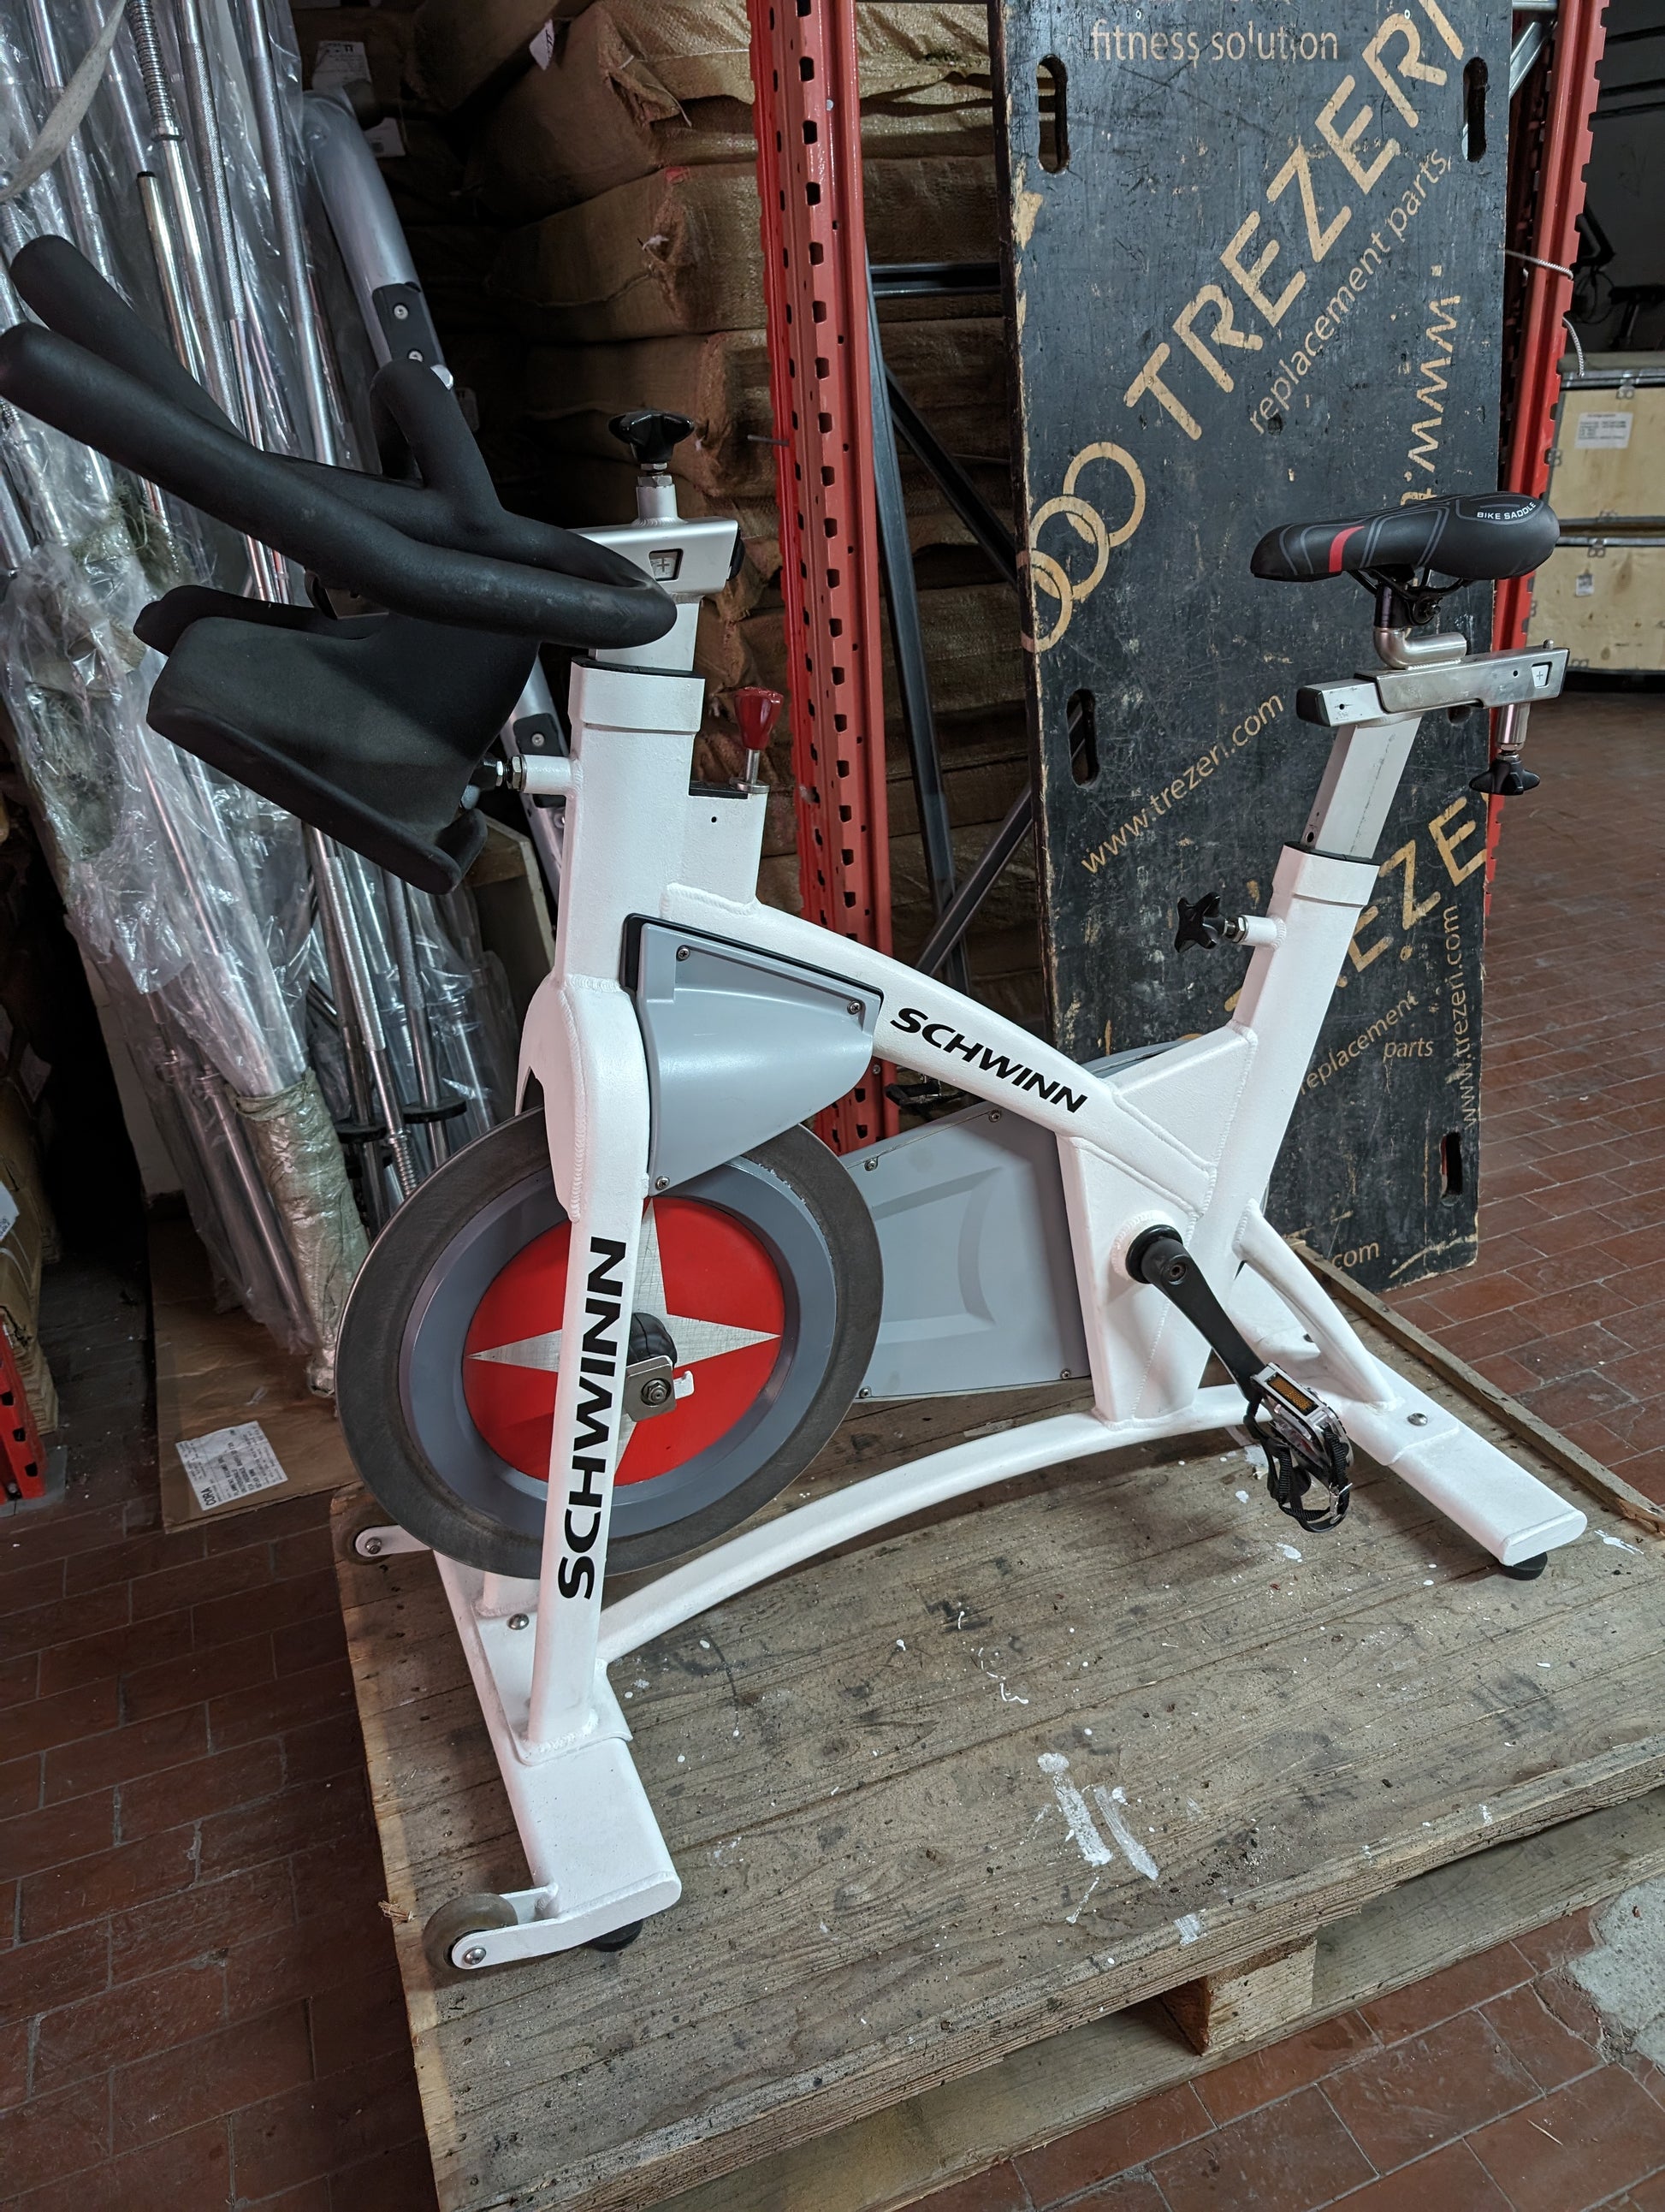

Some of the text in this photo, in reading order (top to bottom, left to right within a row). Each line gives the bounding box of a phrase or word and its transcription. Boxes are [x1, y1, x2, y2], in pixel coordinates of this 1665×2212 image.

[1090, 18, 1200, 62] fitness
[1250, 232, 1390, 435] replacement
[1477, 501, 1537, 520] BIKE SADDLE
[890, 1007, 1088, 1113] SCHWINN
[1382, 1036, 1434, 1064] parts
[1442, 904, 1479, 1130] www.trezeri.com
[558, 1236, 627, 1600] SCHWINN
